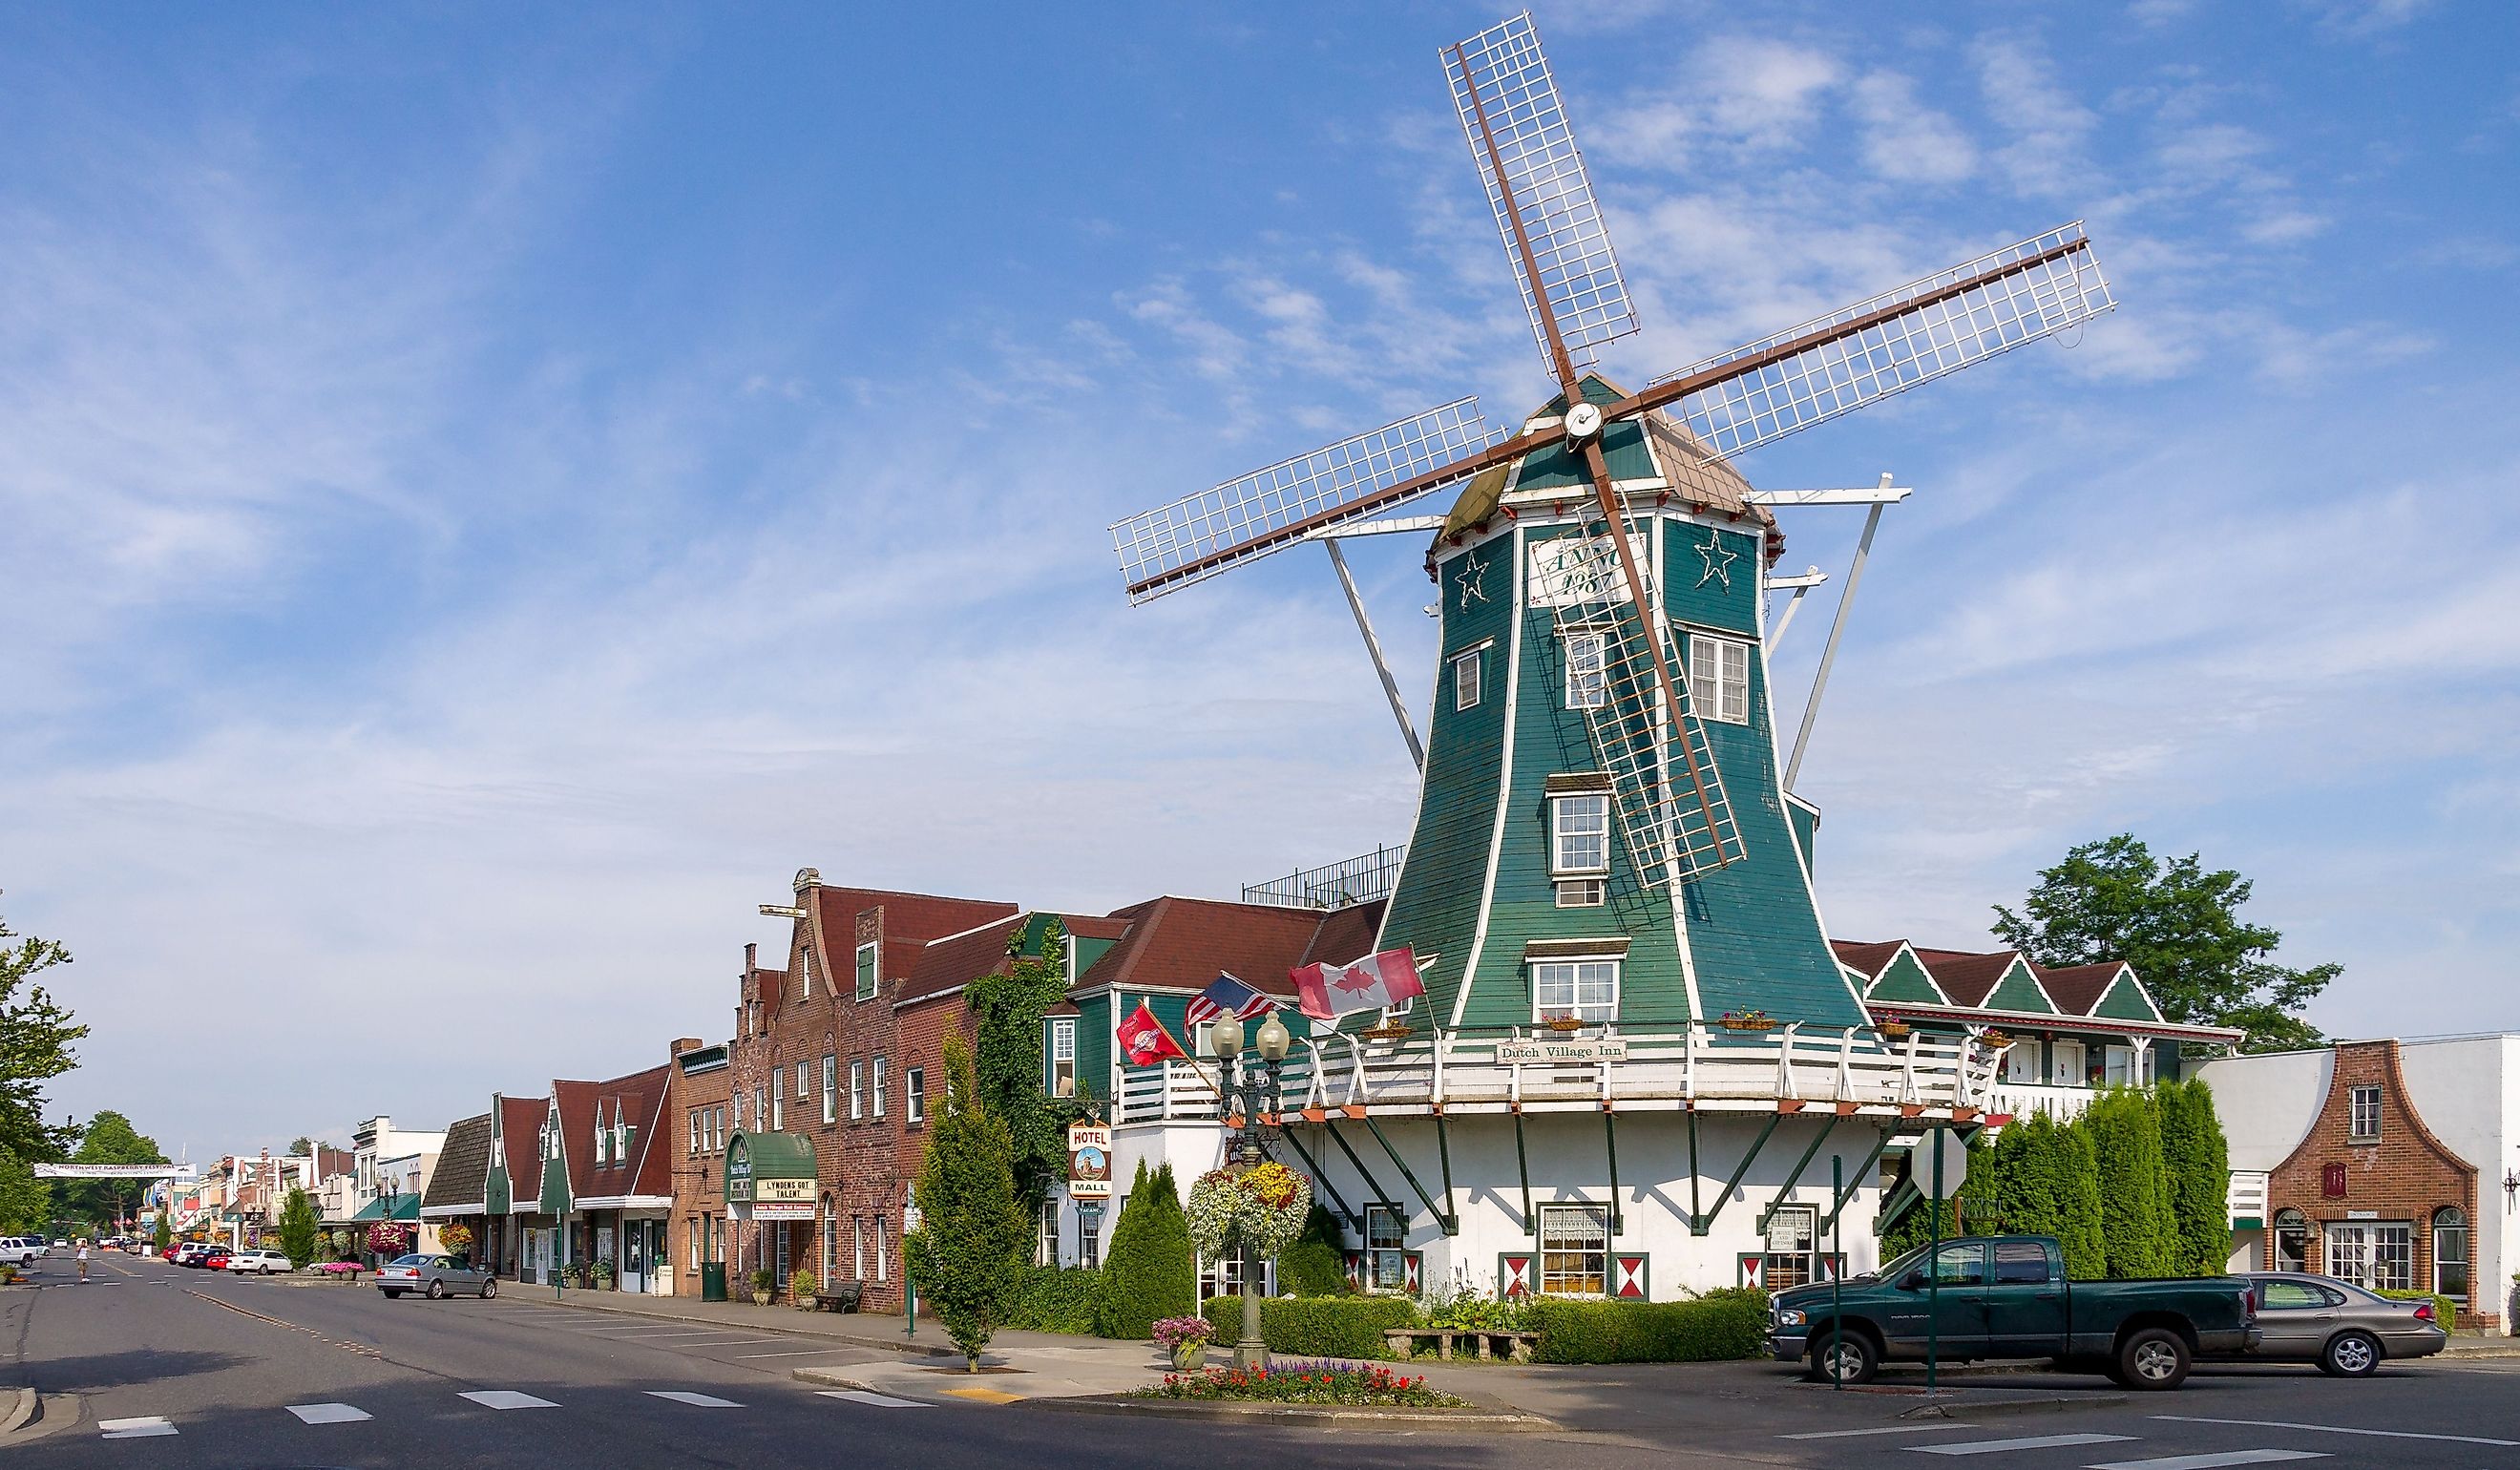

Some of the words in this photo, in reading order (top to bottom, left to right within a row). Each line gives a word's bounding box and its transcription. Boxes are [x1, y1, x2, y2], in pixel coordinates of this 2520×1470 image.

[1562, 572, 1615, 596] 1987
[1502, 1047, 1540, 1059] Dutch
[1546, 1046, 1592, 1059] Village
[1599, 1045, 1622, 1056] Inn
[1074, 1132, 1106, 1145] HOTEL
[766, 1181, 796, 1189] LYNDENS
